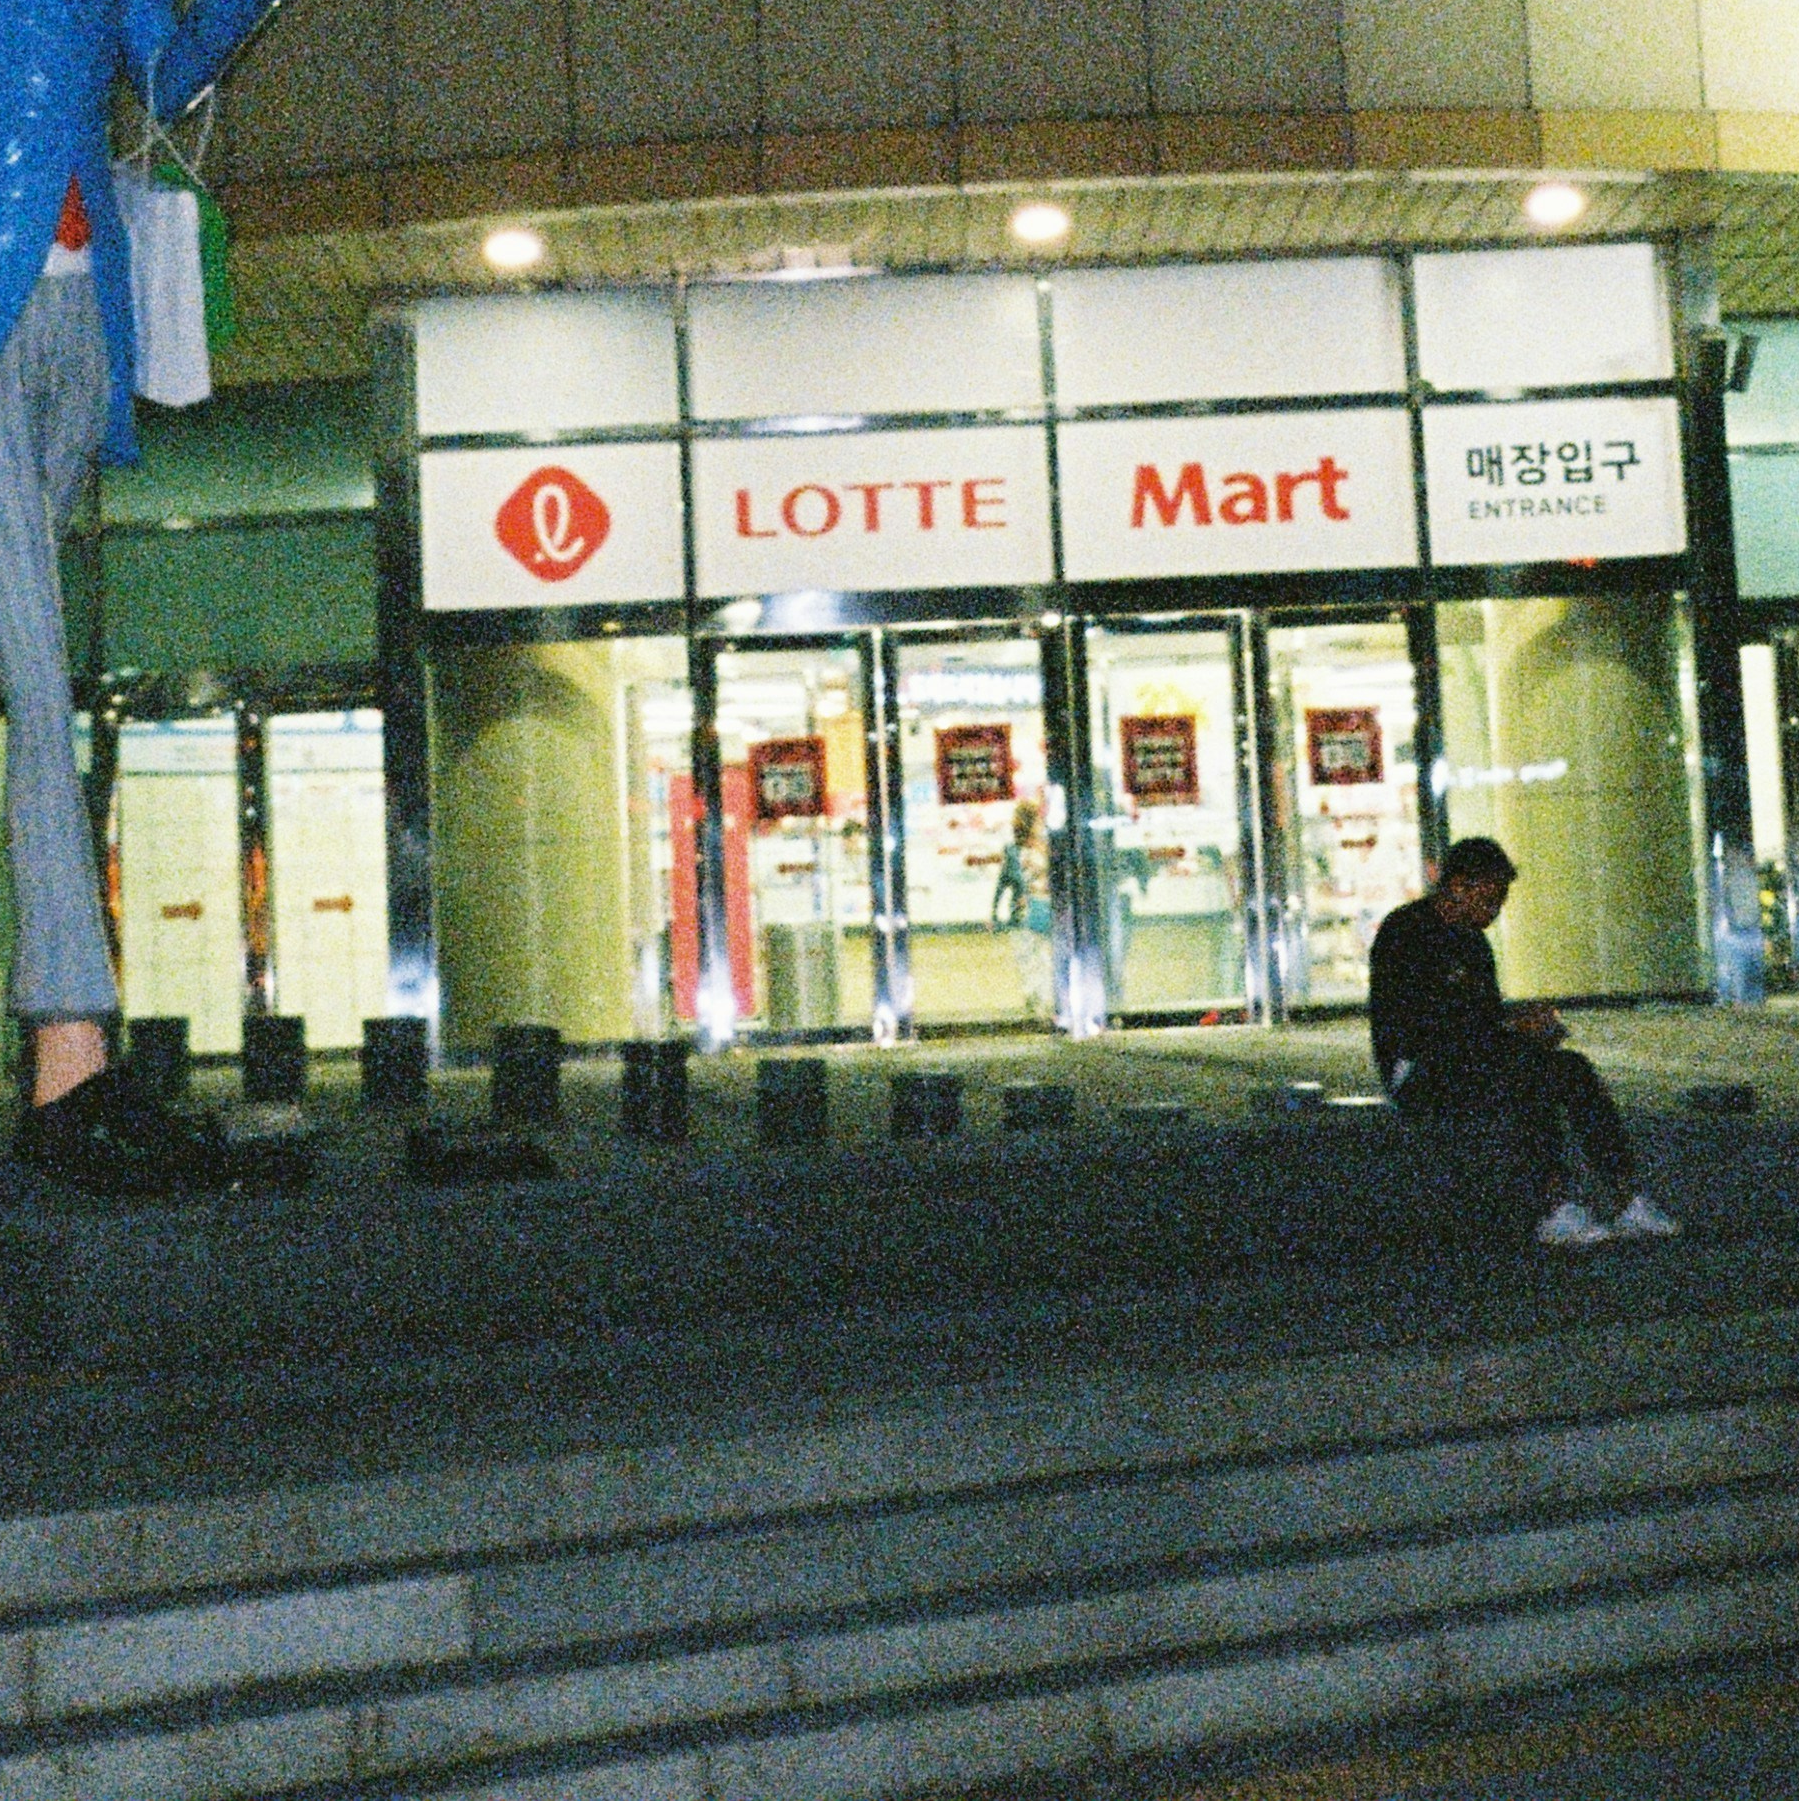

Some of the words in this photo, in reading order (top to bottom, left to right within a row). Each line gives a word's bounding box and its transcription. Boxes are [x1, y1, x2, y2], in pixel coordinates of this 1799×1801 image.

[1465, 439, 1641, 486] 매장입구
[735, 478, 1006, 537] LOTTE
[1130, 455, 1351, 529] Mart
[1468, 494, 1607, 520] ENTRANCE
